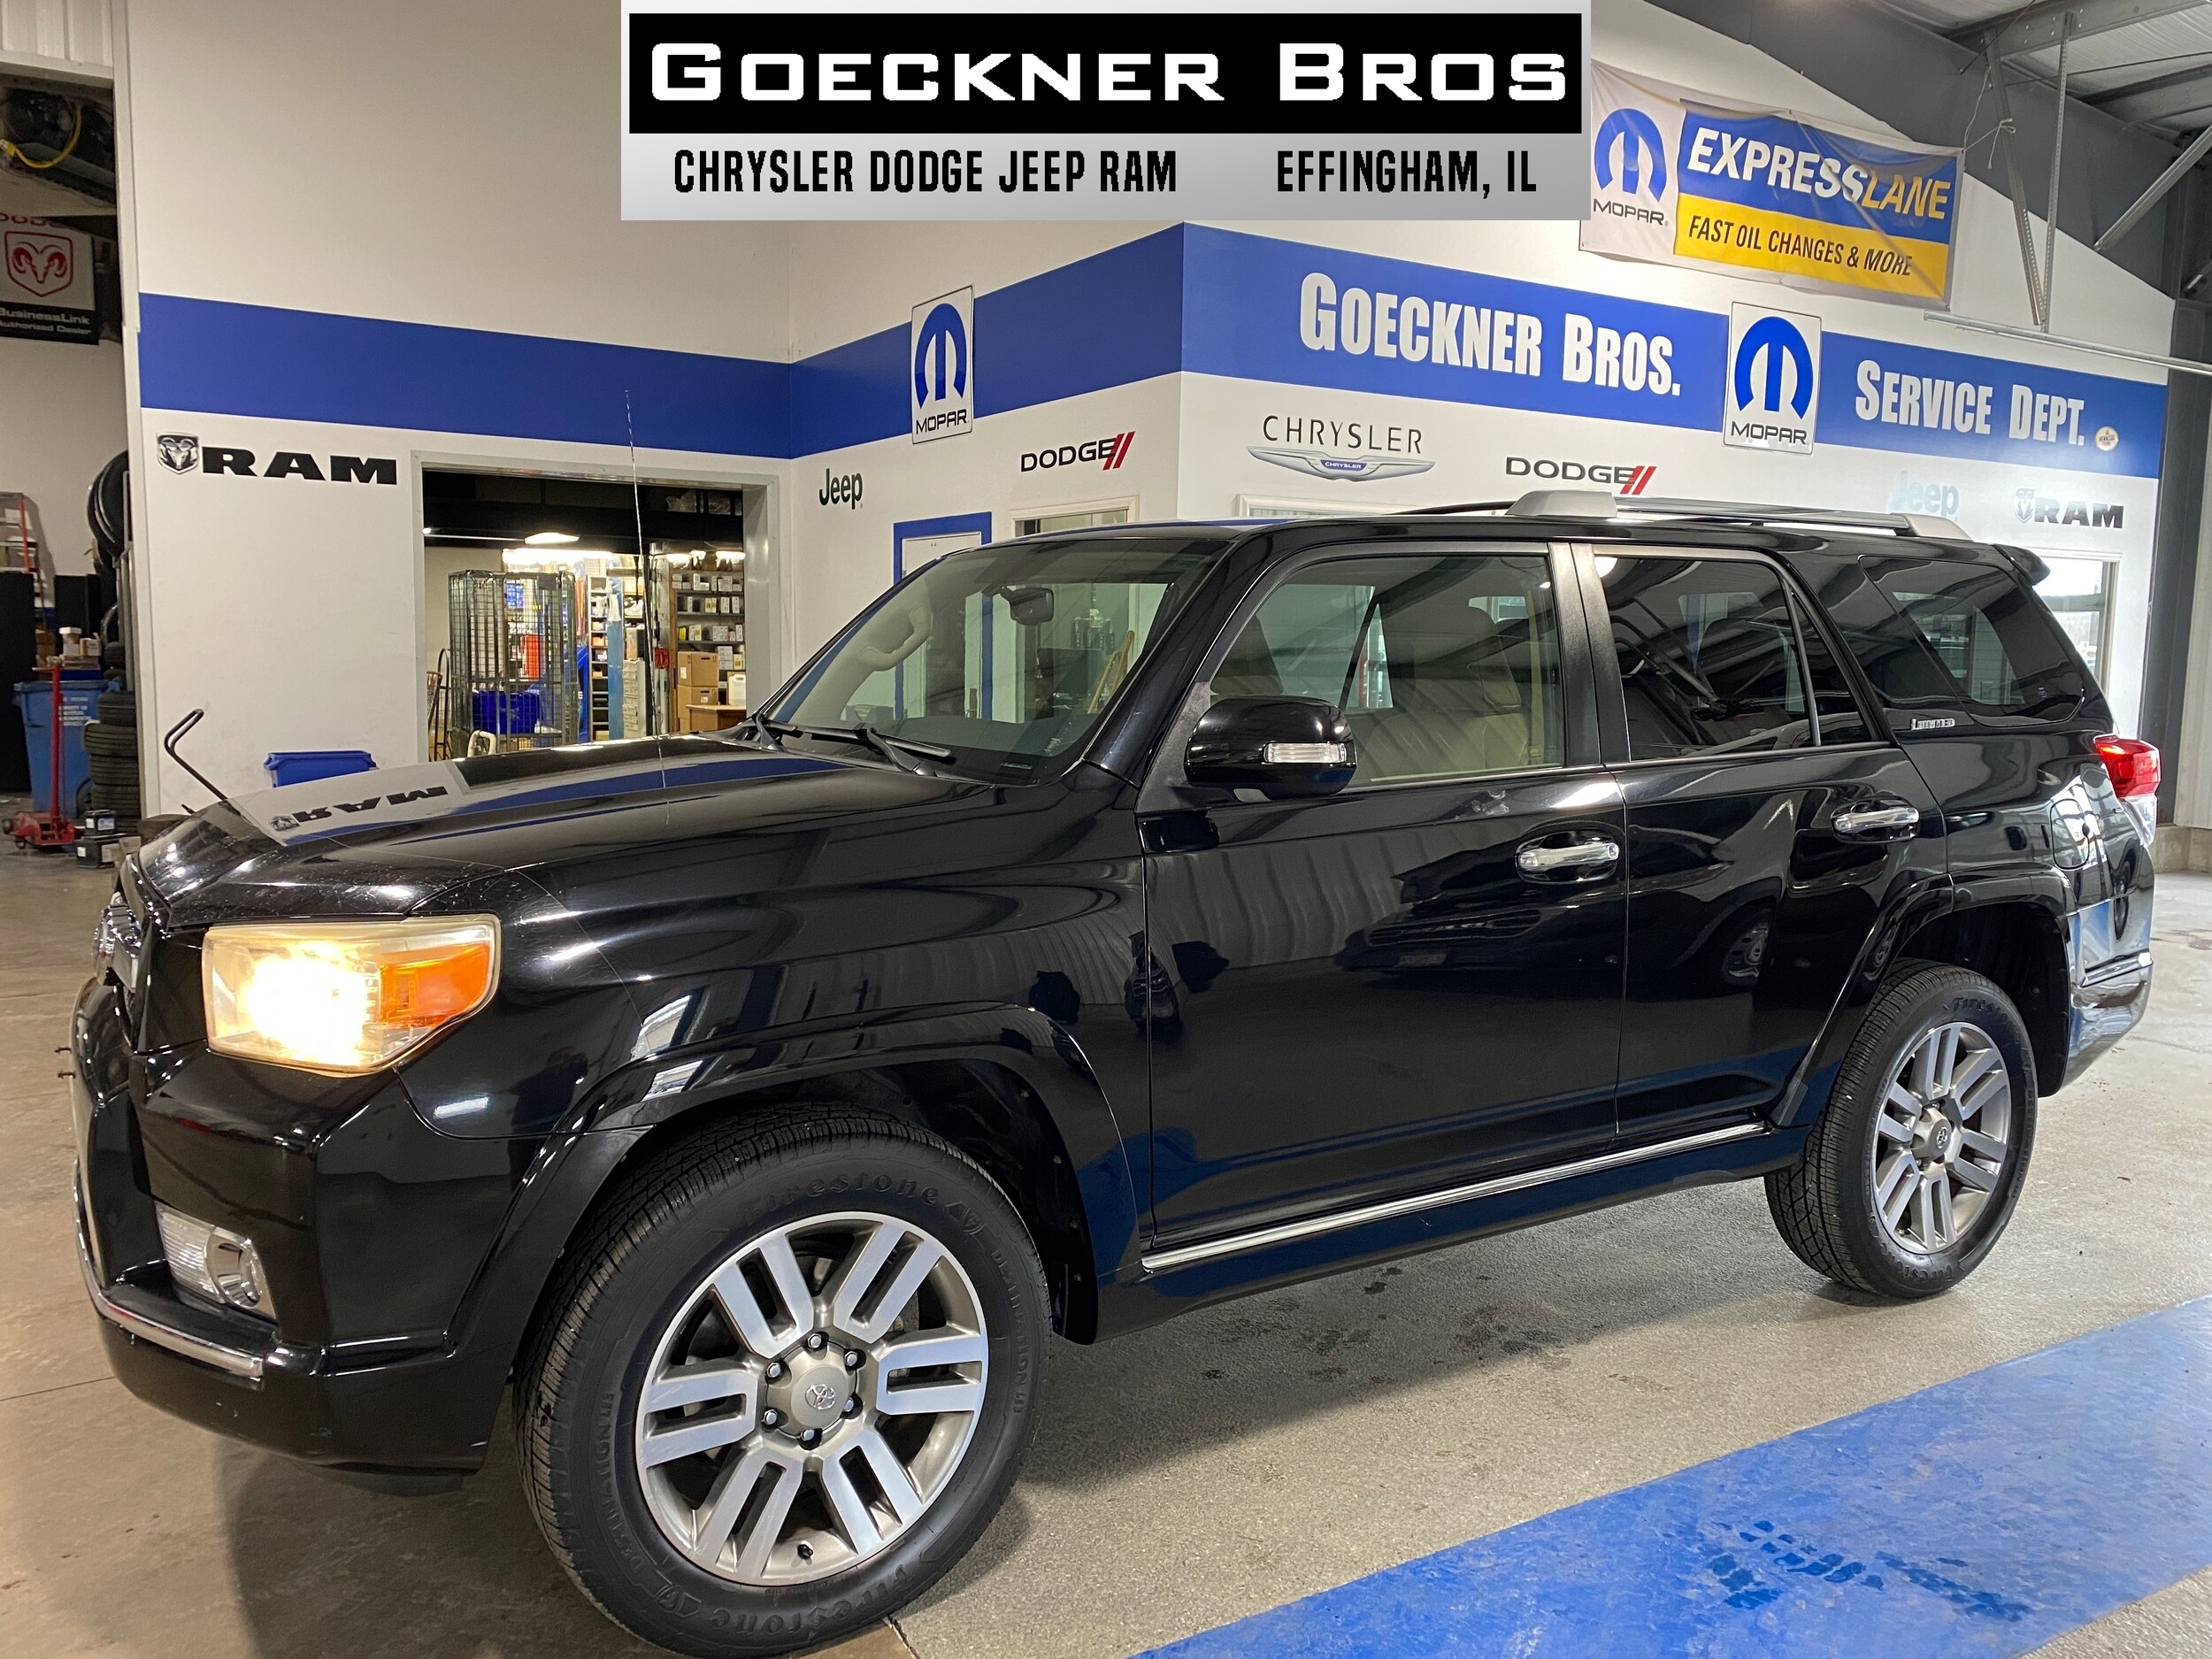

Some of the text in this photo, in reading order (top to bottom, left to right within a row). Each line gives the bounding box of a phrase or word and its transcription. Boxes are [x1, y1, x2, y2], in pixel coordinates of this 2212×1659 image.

[1688, 215, 1913, 277] FAST OIL CHANGES & MORE
[1855, 359, 1993, 436] SERVICE
[916, 408, 968, 434] MOPAR
[1262, 414, 1424, 455] CHRYSLER
[1731, 420, 1808, 446] MOPAR
[201, 446, 397, 486] RAM
[1020, 436, 1118, 472] DODGE
[1505, 456, 1636, 486] DODGE
[818, 468, 864, 510] Jeep
[1886, 469, 1960, 516] Jeep
[2034, 497, 2124, 529] RAM
[736, 1170, 941, 1226] Firestone
[709, 1564, 909, 1639] Firestone
